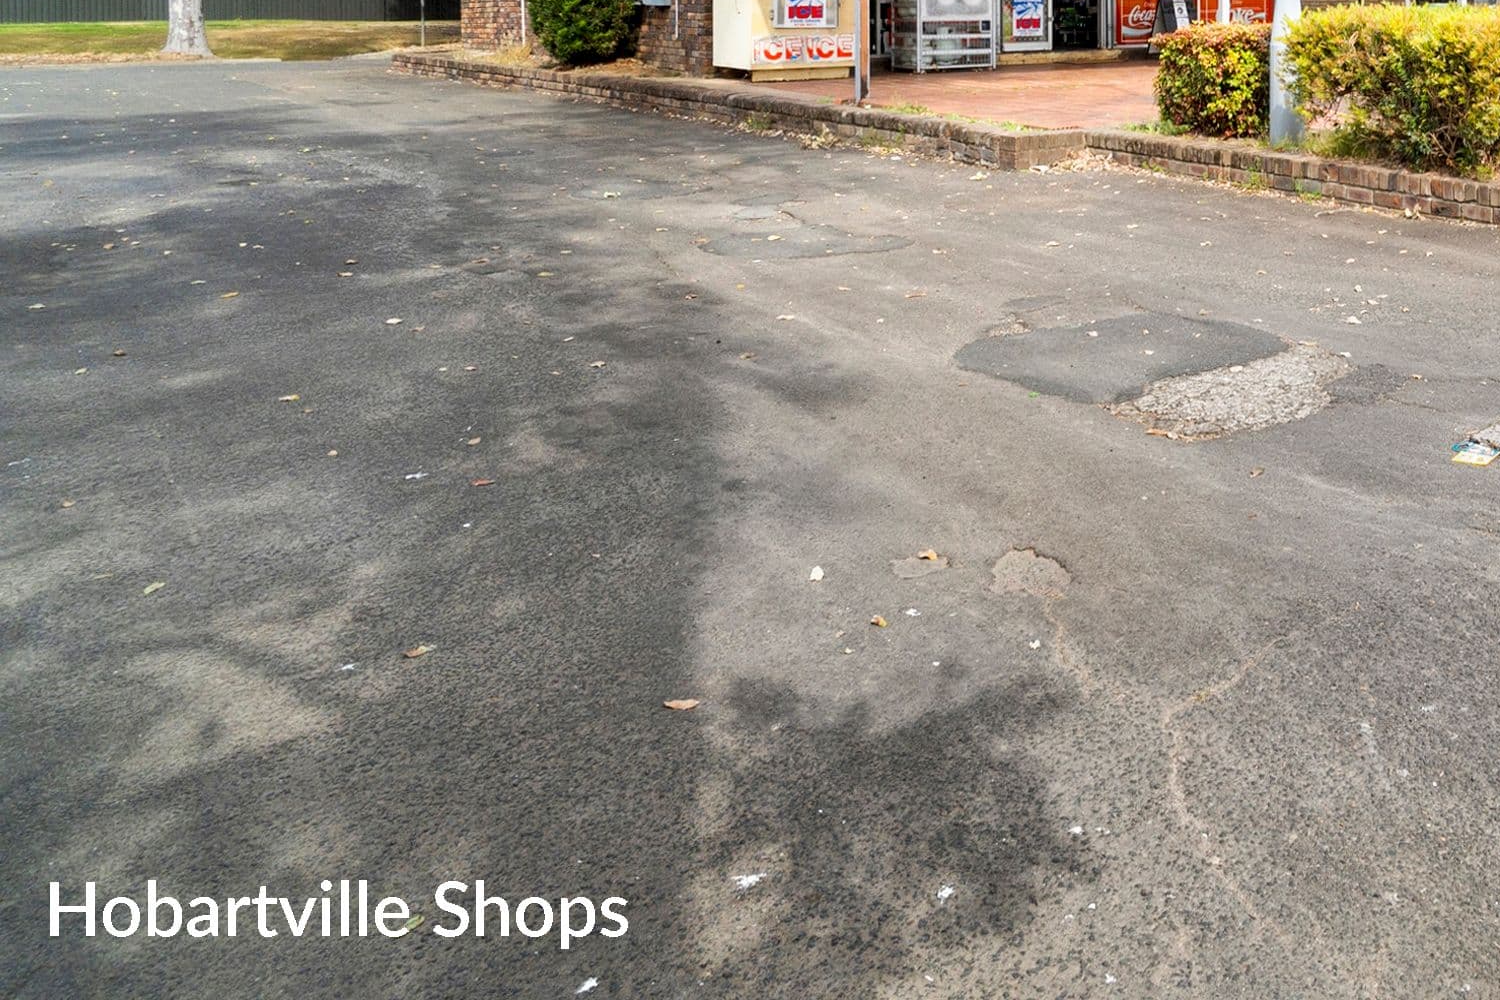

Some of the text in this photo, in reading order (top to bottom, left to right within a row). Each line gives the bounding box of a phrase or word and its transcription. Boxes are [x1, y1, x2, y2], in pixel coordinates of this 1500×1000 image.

[787, 5, 824, 19] ICE
[1015, 18, 1041, 29] ICE
[805, 34, 853, 60] ICE
